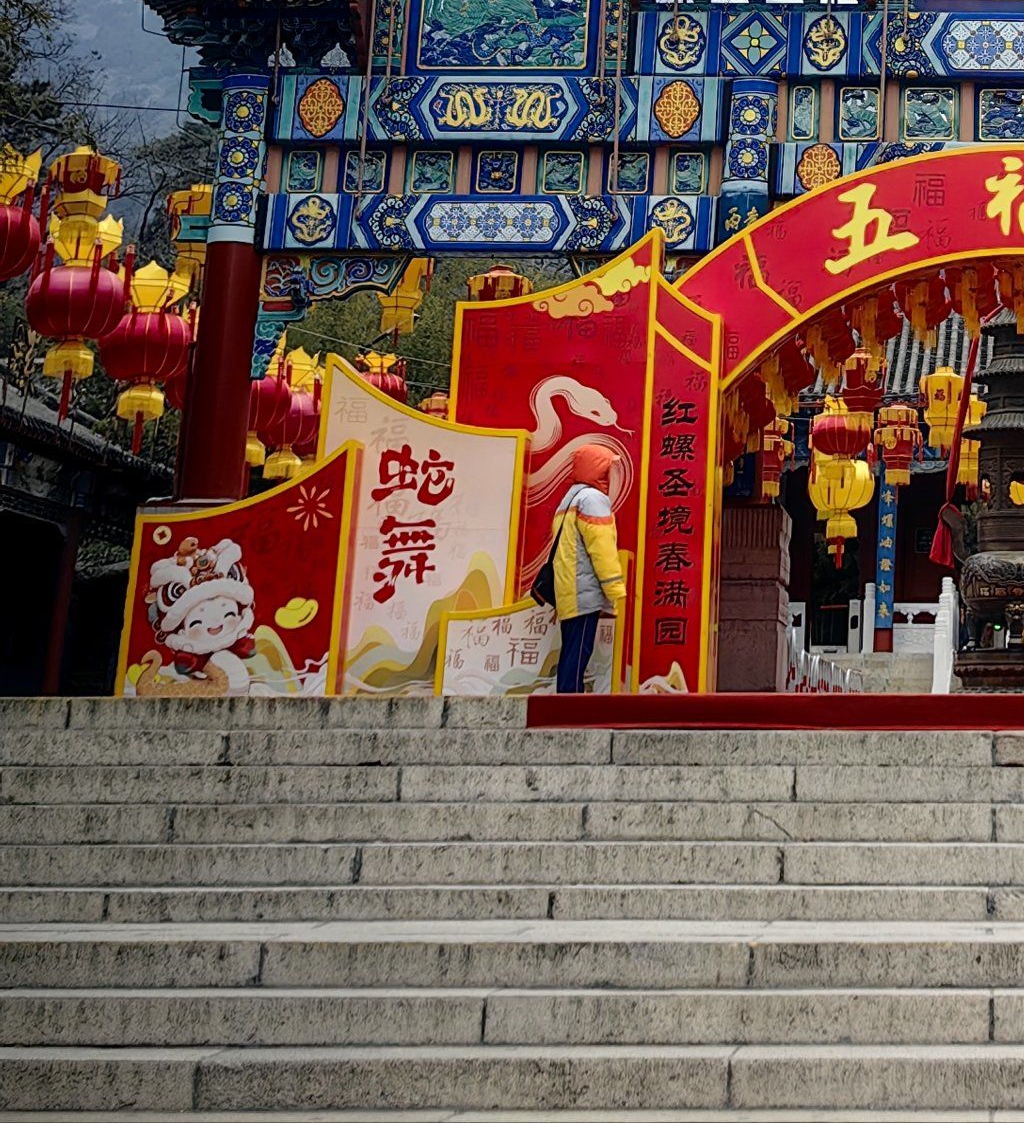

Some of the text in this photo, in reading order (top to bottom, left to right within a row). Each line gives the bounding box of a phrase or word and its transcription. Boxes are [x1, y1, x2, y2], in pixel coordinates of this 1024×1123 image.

[653, 397, 698, 646] 红螺圣境春满园
[525, 609, 548, 636] 福
[506, 638, 542, 667] 福
